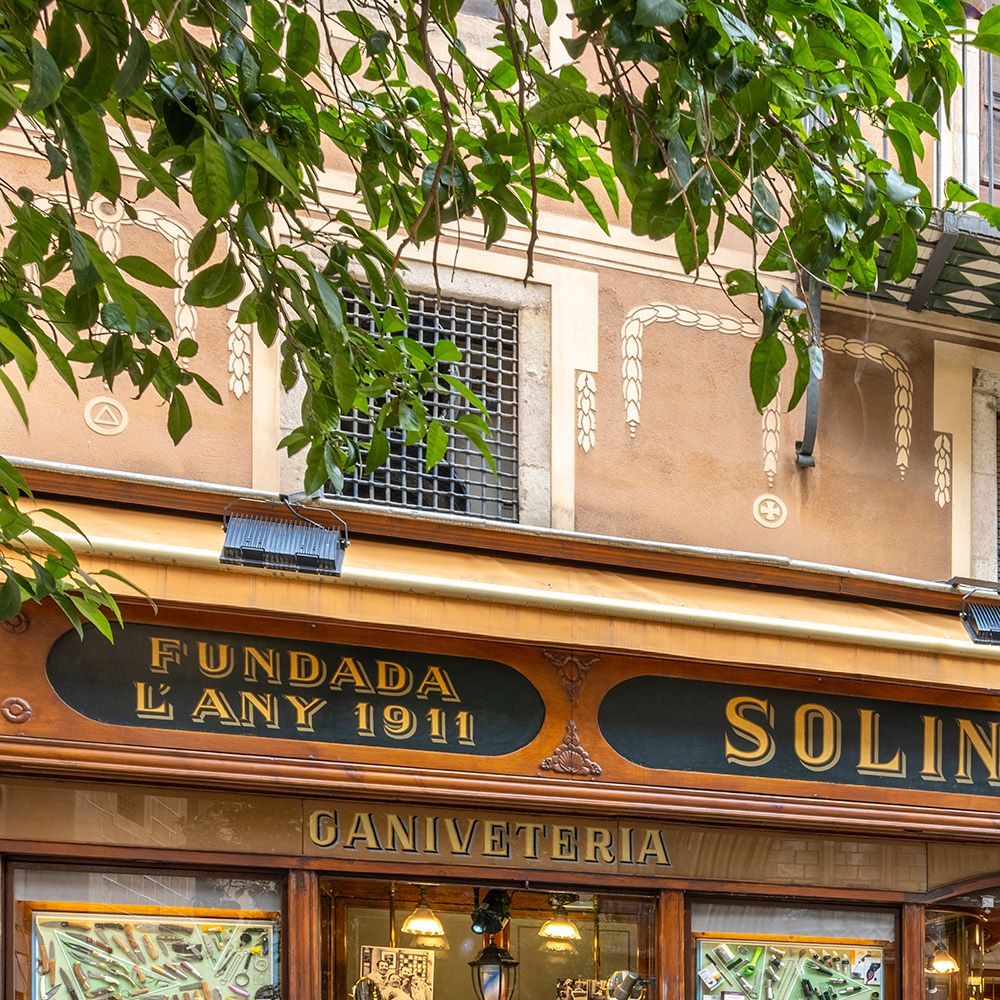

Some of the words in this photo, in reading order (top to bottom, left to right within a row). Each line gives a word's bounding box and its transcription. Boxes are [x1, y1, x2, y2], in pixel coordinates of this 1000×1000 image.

[150, 636, 462, 702] FUNDADA
[354, 701, 477, 746] 1911
[308, 808, 673, 867] GANIVETERIA
